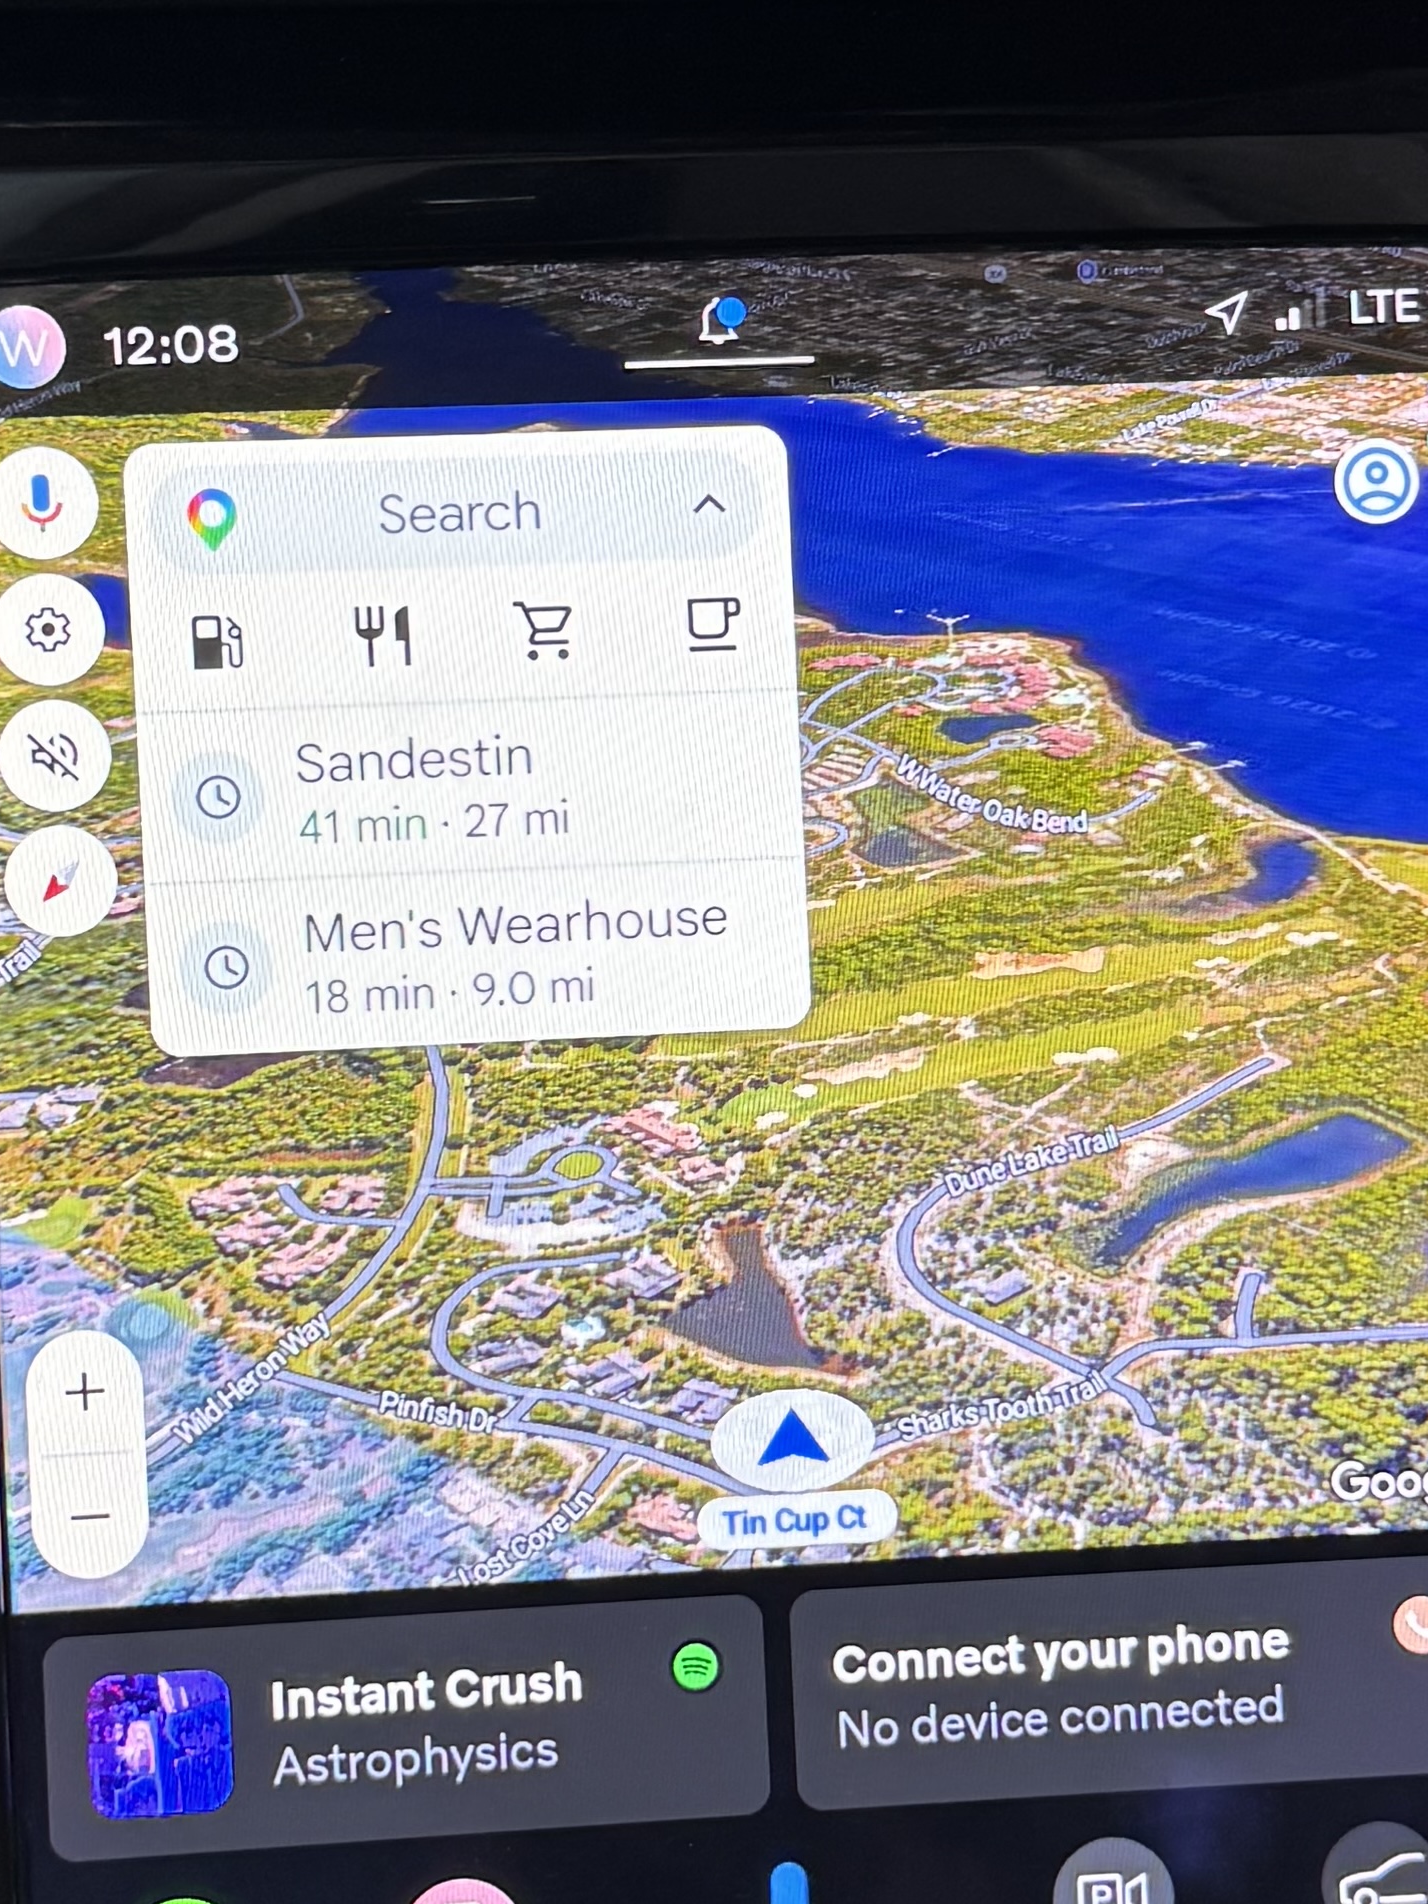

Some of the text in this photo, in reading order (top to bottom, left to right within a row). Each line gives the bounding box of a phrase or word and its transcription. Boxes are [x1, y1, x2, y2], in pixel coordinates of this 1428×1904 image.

[1350, 288, 1420, 325] LTE
[103, 325, 239, 366] 12:08
[379, 490, 541, 534] Search
[296, 736, 532, 784] Sandestin
[300, 802, 569, 845] 41 min 27 mi
[920, 767, 983, 813] Water
[983, 799, 1031, 829] Oak
[1031, 809, 1088, 833] Bend
[305, 901, 727, 954] Men's Wearhouse
[306, 969, 595, 1014] 18 min 9.0 mi
[945, 1125, 1120, 1198] Dune Lake Trail
[174, 1311, 331, 1445] Wild Heron Way
[379, 1391, 499, 1434] Pinfish Dr
[898, 1370, 1107, 1441] Sharks Tooth Trail
[511, 1513, 569, 1560] Cove
[561, 1490, 595, 1522] Ln
[723, 1505, 867, 1537] Tin Cup Ct
[833, 1624, 1291, 1685] Connect your phone
[272, 1661, 583, 1720] Instant Crush
[837, 1685, 1286, 1749] No device connected
[273, 1733, 559, 1789] Astrophysics
